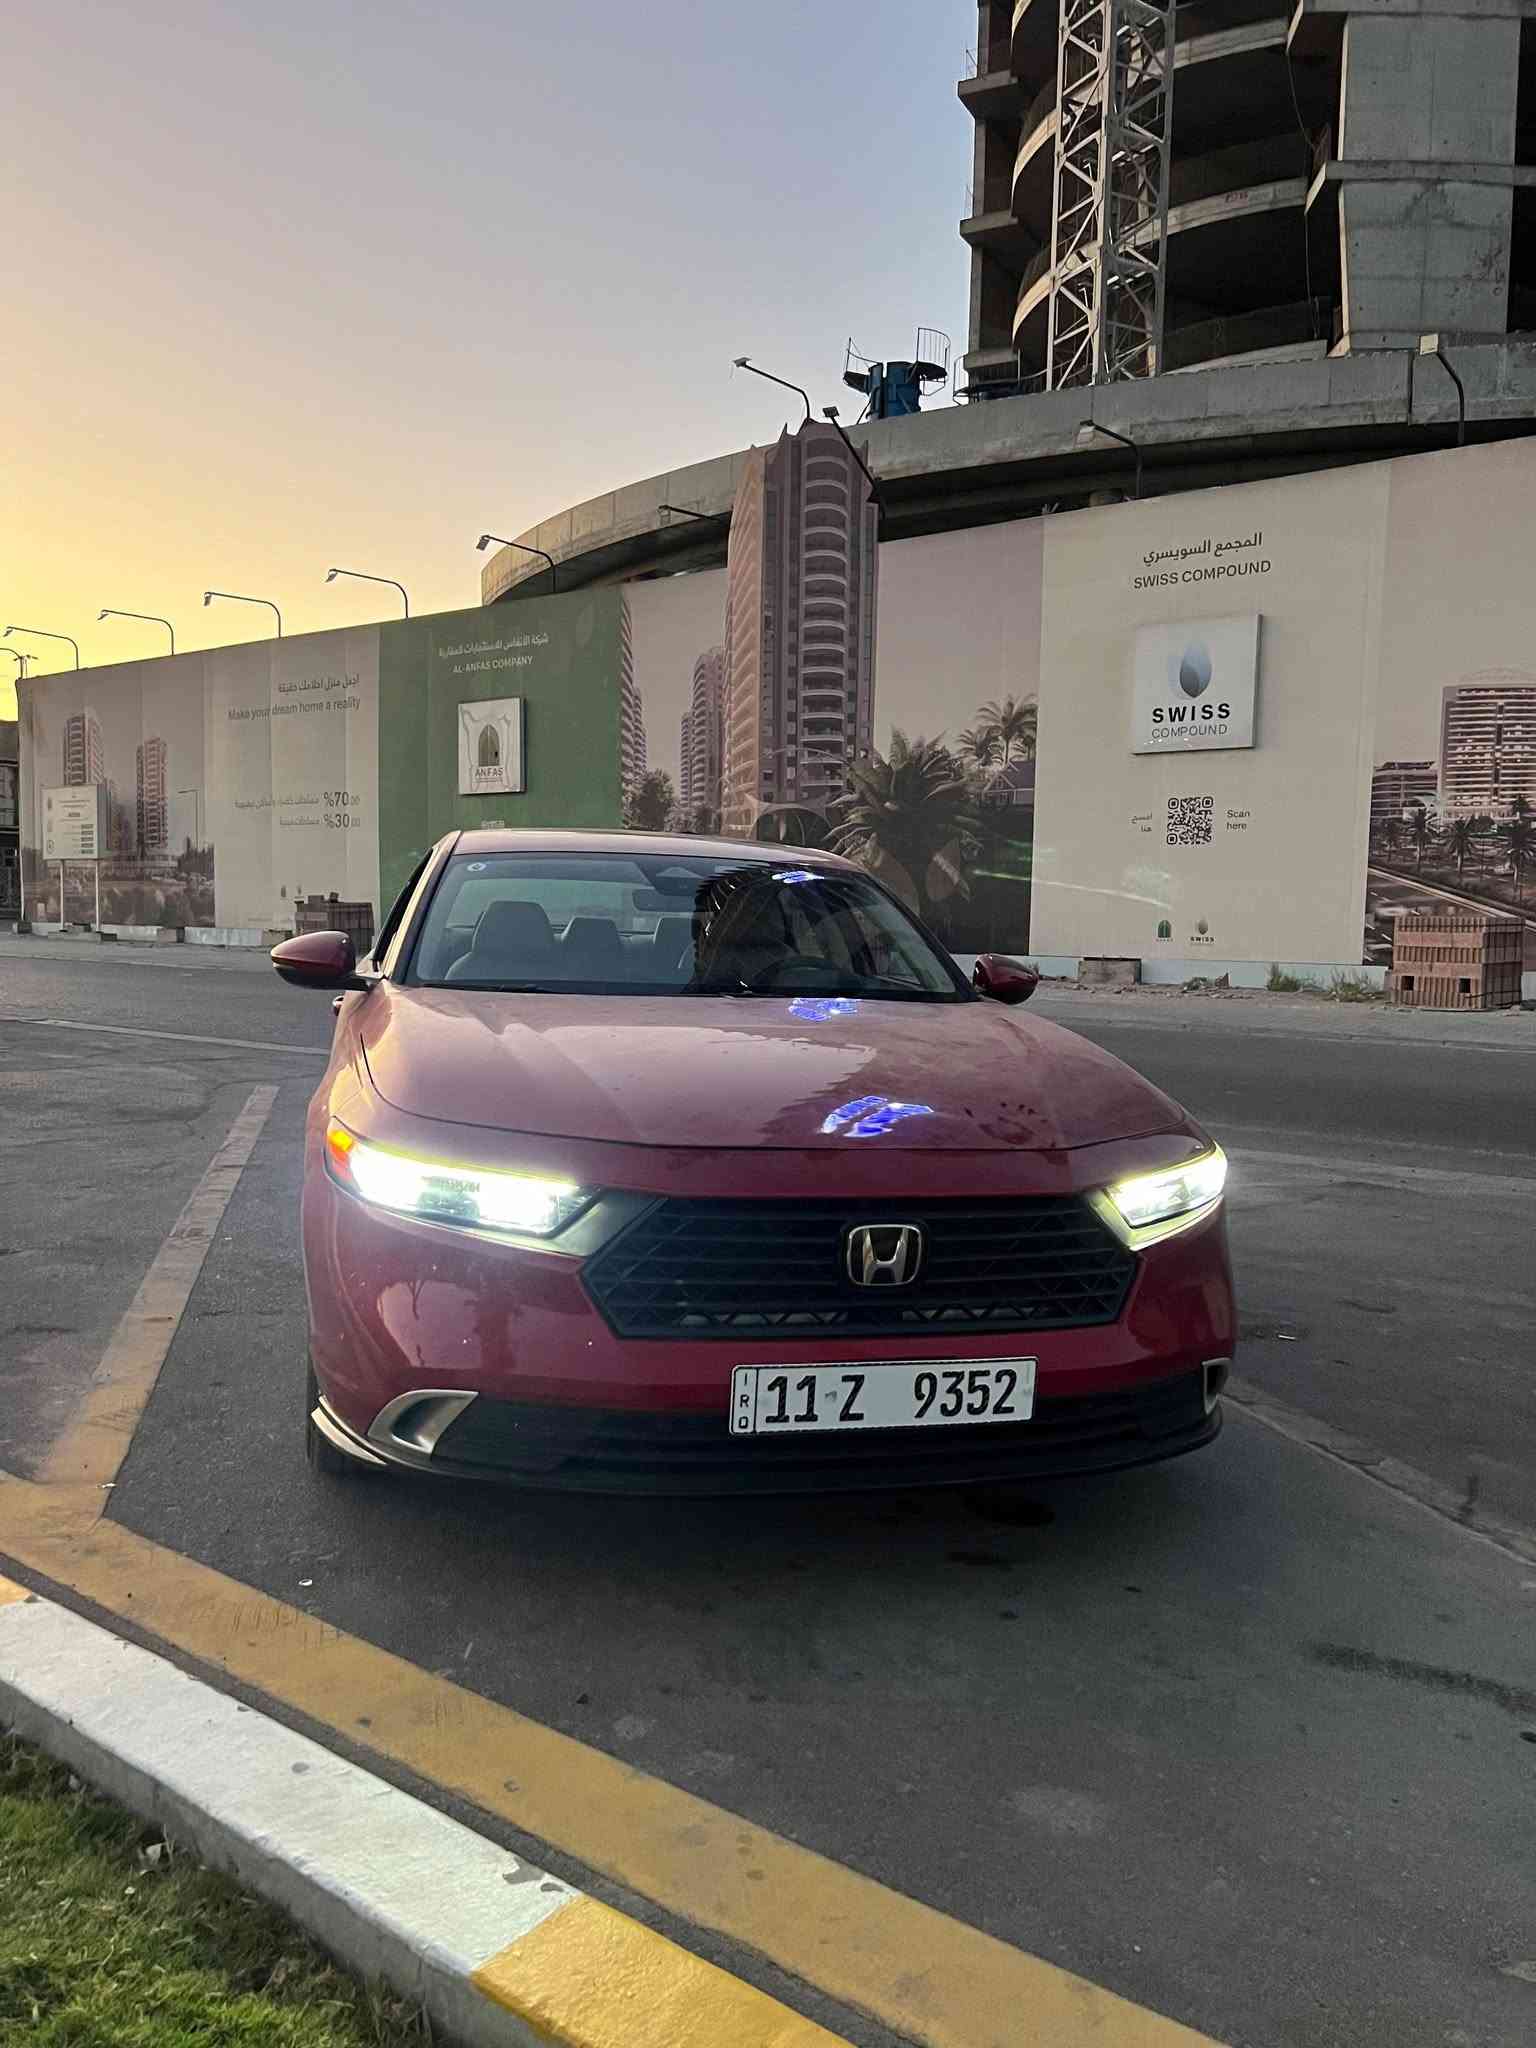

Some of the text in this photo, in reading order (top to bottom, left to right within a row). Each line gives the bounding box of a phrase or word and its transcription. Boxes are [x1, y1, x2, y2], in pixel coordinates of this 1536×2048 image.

[1143, 532, 1262, 567] المجمع السويسري
[1133, 560, 1272, 590] SWISS COMPOUND
[491, 655, 533, 670] COMPANY
[271, 703, 298, 715] dream
[300, 701, 323, 713] home
[333, 696, 361, 711] reality
[1151, 703, 1231, 724] SWISS
[1151, 723, 1228, 739] COMPOUND
[474, 767, 504, 777] ANFAS
[1226, 809, 1250, 819] Scan
[1226, 821, 1248, 831] here
[765, 1368, 1017, 1423] 11 Z 9352
